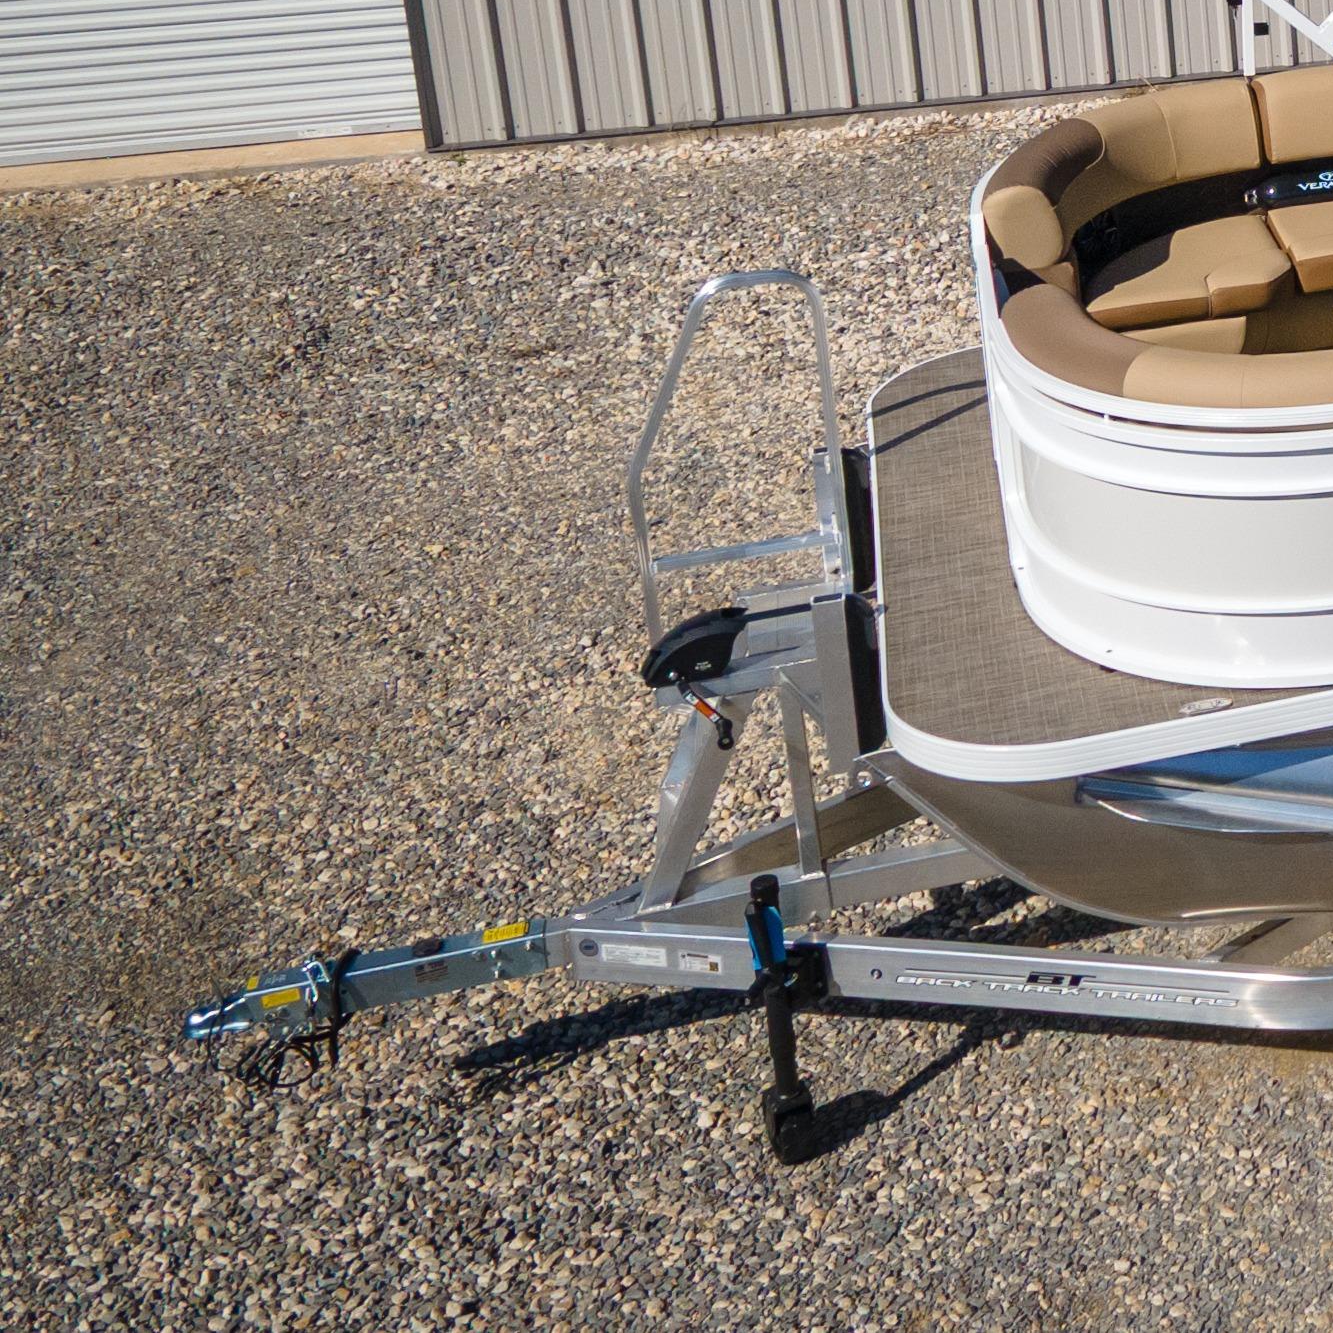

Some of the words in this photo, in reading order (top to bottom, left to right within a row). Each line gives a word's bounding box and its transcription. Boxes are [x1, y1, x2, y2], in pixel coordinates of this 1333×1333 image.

[895, 974, 977, 989] BACK
[982, 981, 1083, 996] TRACK
[1089, 988, 1241, 1008] TRAILERS
